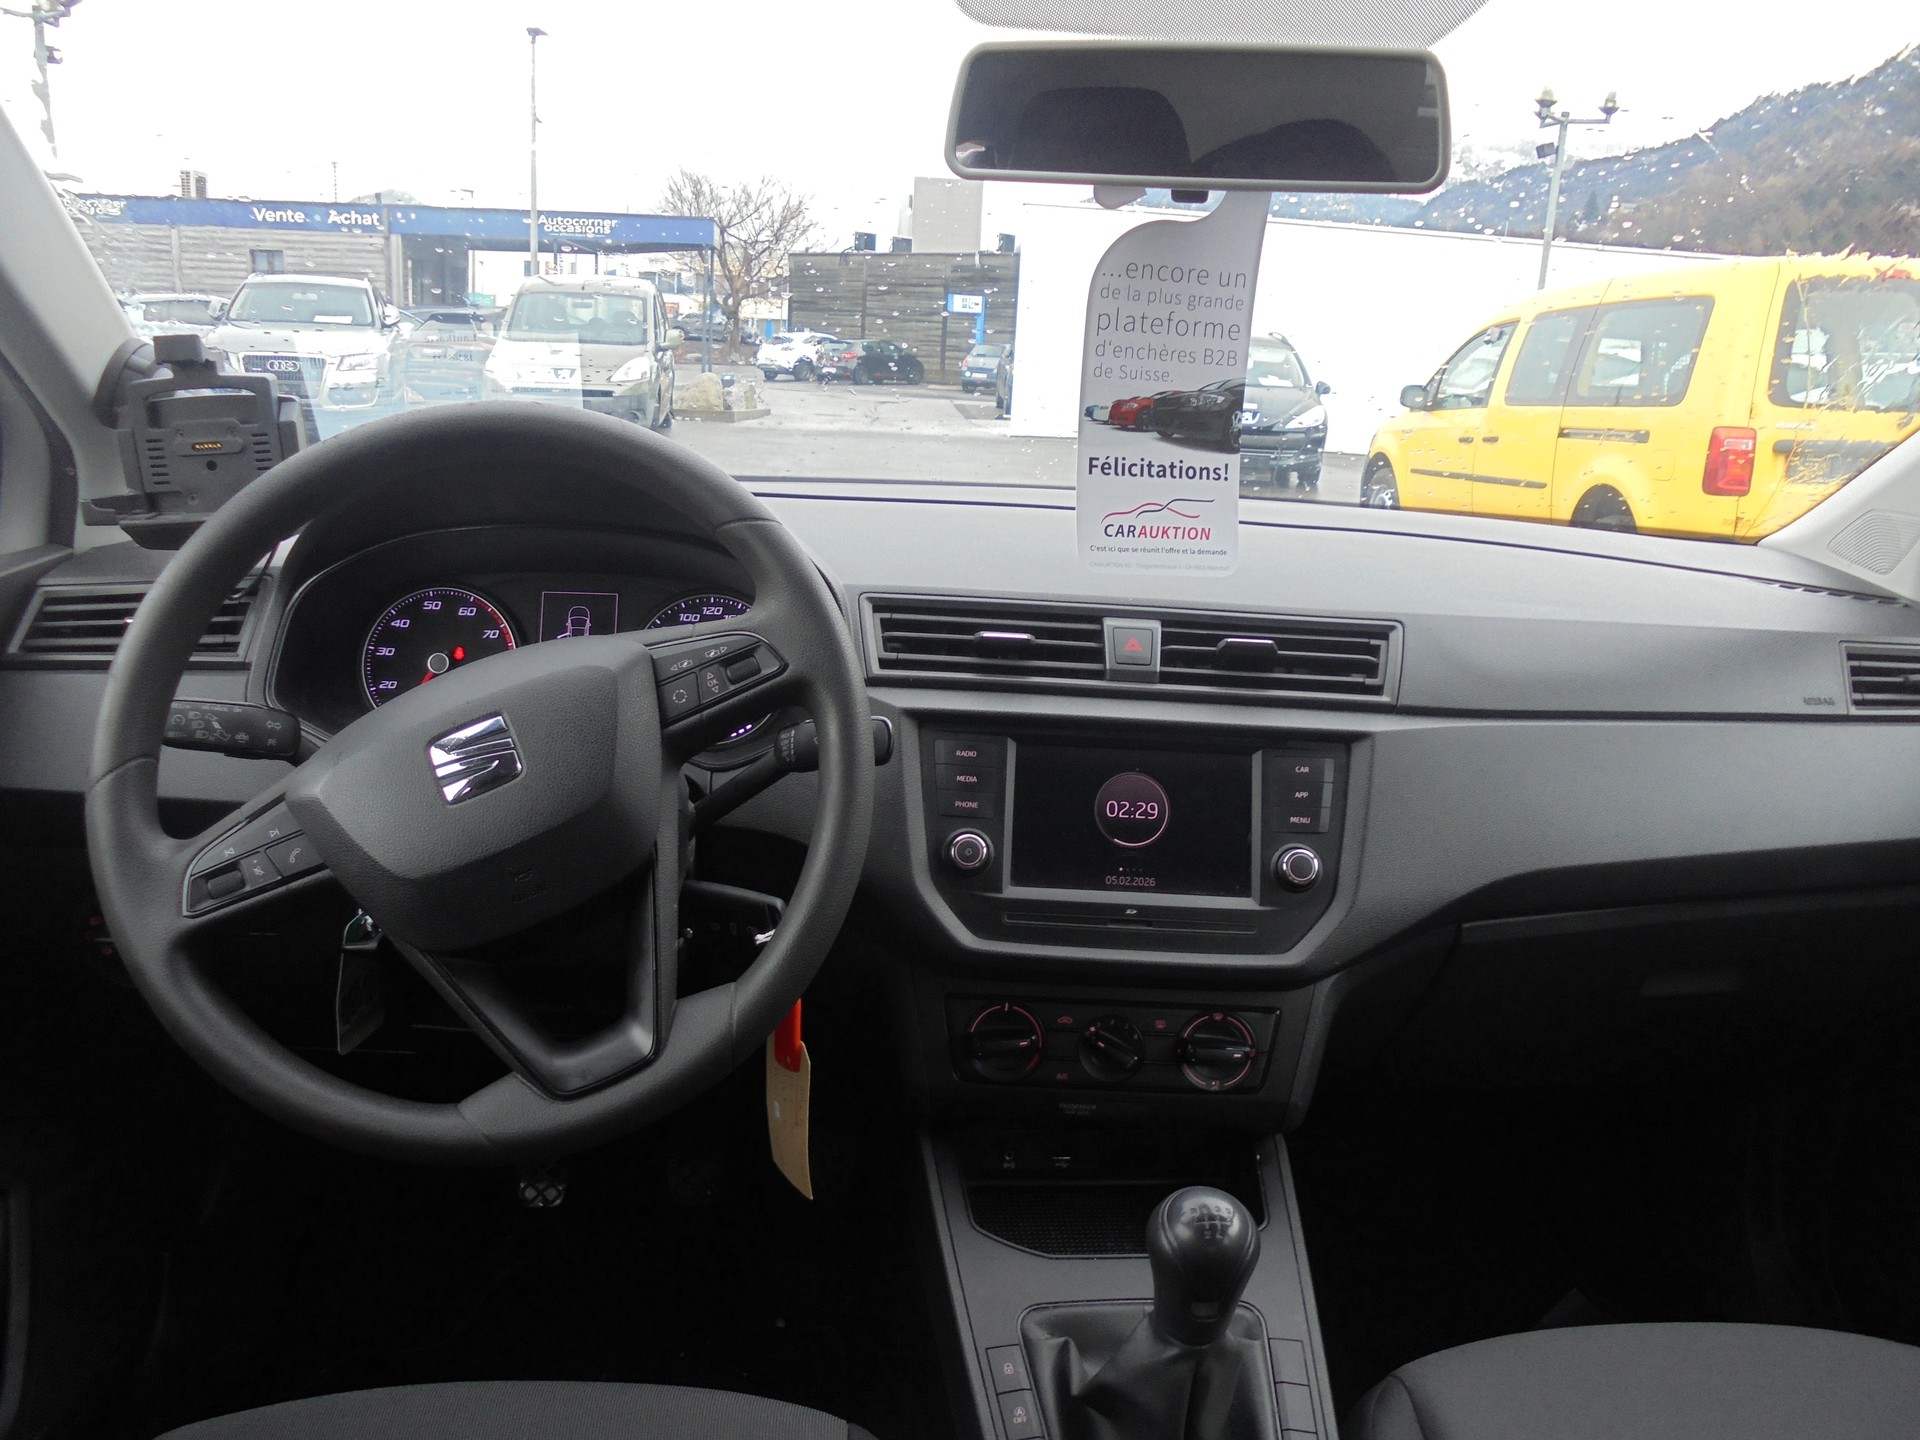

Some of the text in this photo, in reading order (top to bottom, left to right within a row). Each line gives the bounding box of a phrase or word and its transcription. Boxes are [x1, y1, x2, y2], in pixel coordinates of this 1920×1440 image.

[252, 207, 380, 226] Vente Achat
[538, 214, 618, 228] Autocorner
[543, 224, 612, 234] occasions
[1218, 271, 1247, 289] un
[1100, 283, 1245, 311] de la plus grande
[1096, 307, 1241, 342] plateforme
[1203, 348, 1238, 367] B2B
[1093, 362, 1174, 383] de Suisse.
[1088, 455, 1230, 482] Félicitations!
[1104, 523, 1212, 541] CARAUKTION
[1089, 544, 1107, 552] C'est
[1108, 544, 1116, 552] ici
[1117, 546, 1130, 554] que
[1197, 548, 1228, 556] demande
[423, 601, 442, 610] 50
[702, 606, 723, 615] 120
[458, 607, 477, 616] 60
[679, 613, 700, 622] 100
[390, 619, 411, 628] 40
[482, 630, 500, 639] 70
[375, 647, 396, 656] 30
[379, 680, 398, 689] 20
[707, 678, 719, 687] OK
[956, 775, 978, 783] MEDIA
[1106, 800, 1159, 820] 02:29
[1290, 816, 1311, 824] MENU
[1105, 875, 1156, 887] 05.02.2026
